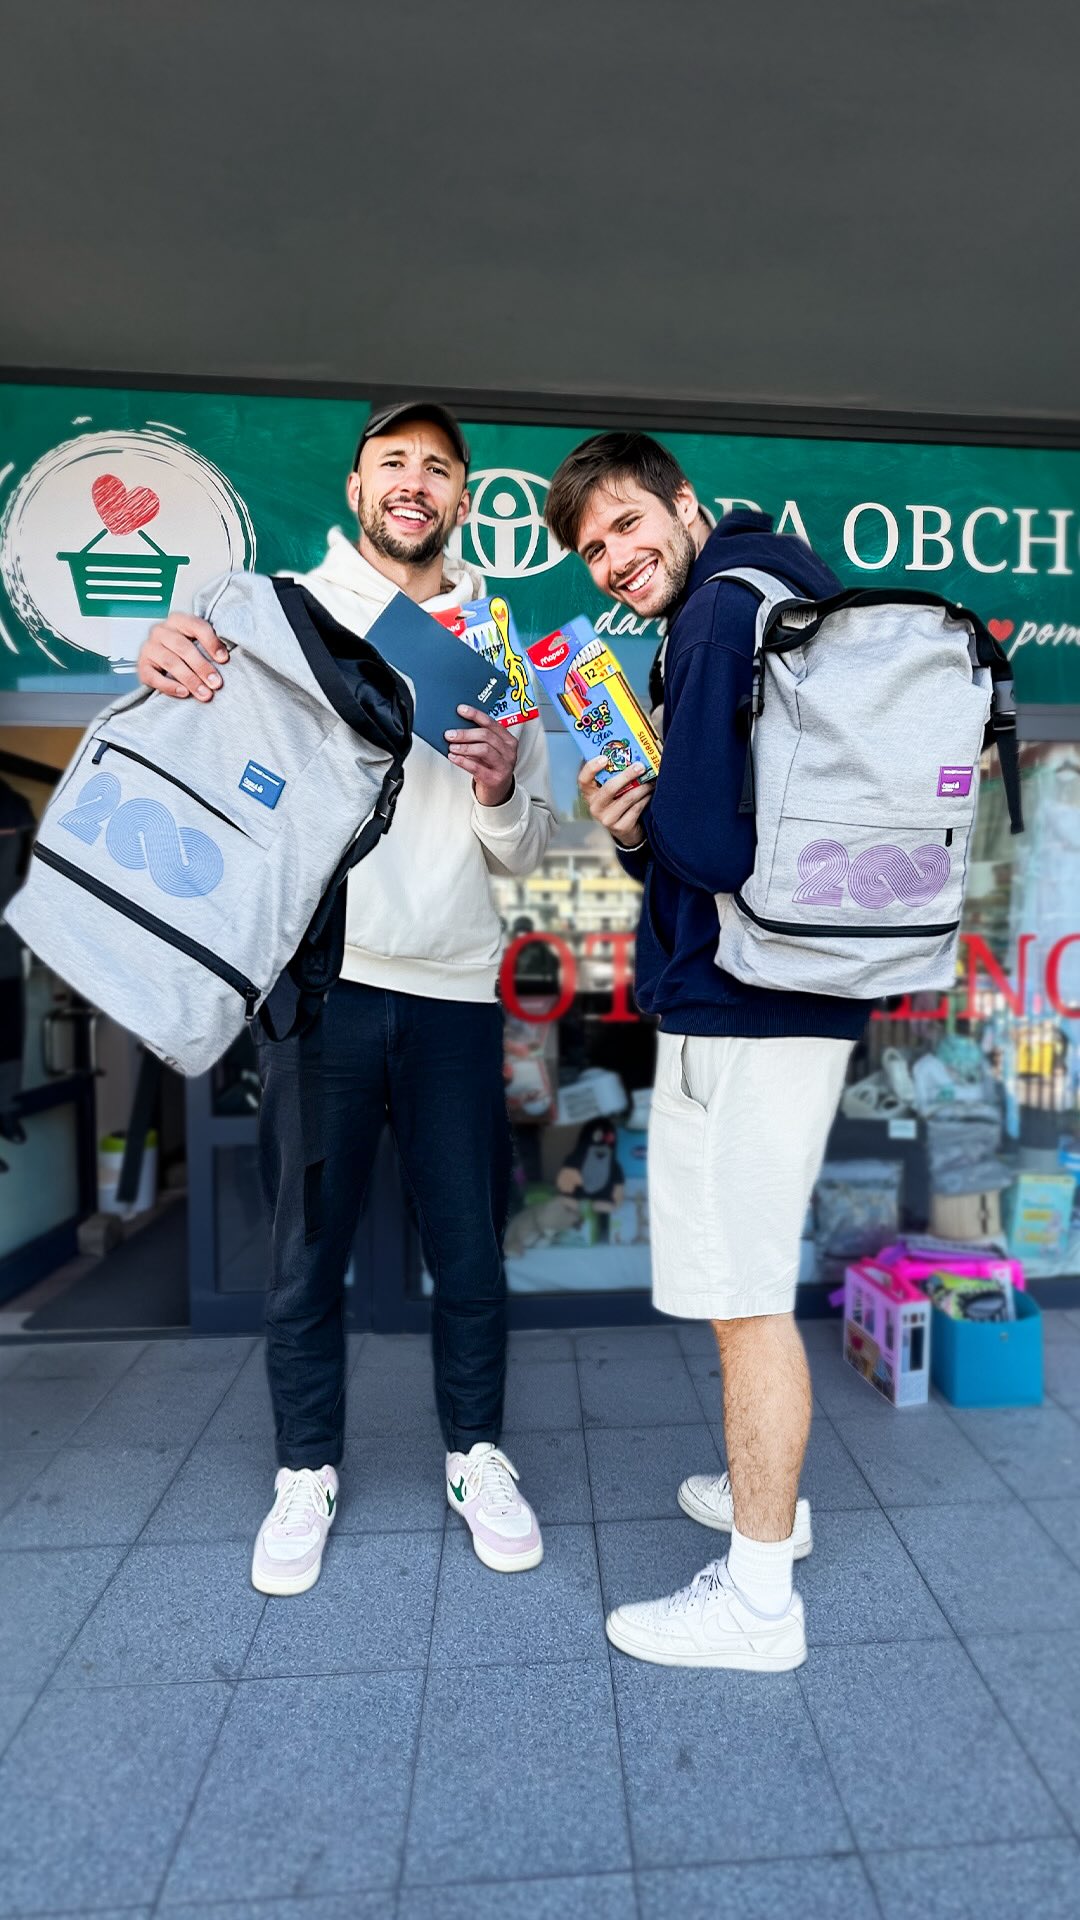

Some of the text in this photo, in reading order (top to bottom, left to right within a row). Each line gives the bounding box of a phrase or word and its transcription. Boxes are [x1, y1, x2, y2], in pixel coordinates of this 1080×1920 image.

[843, 502, 1080, 575] OBCH
[584, 668, 597, 680] 12
[637, 731, 656, 756] GRATIS
